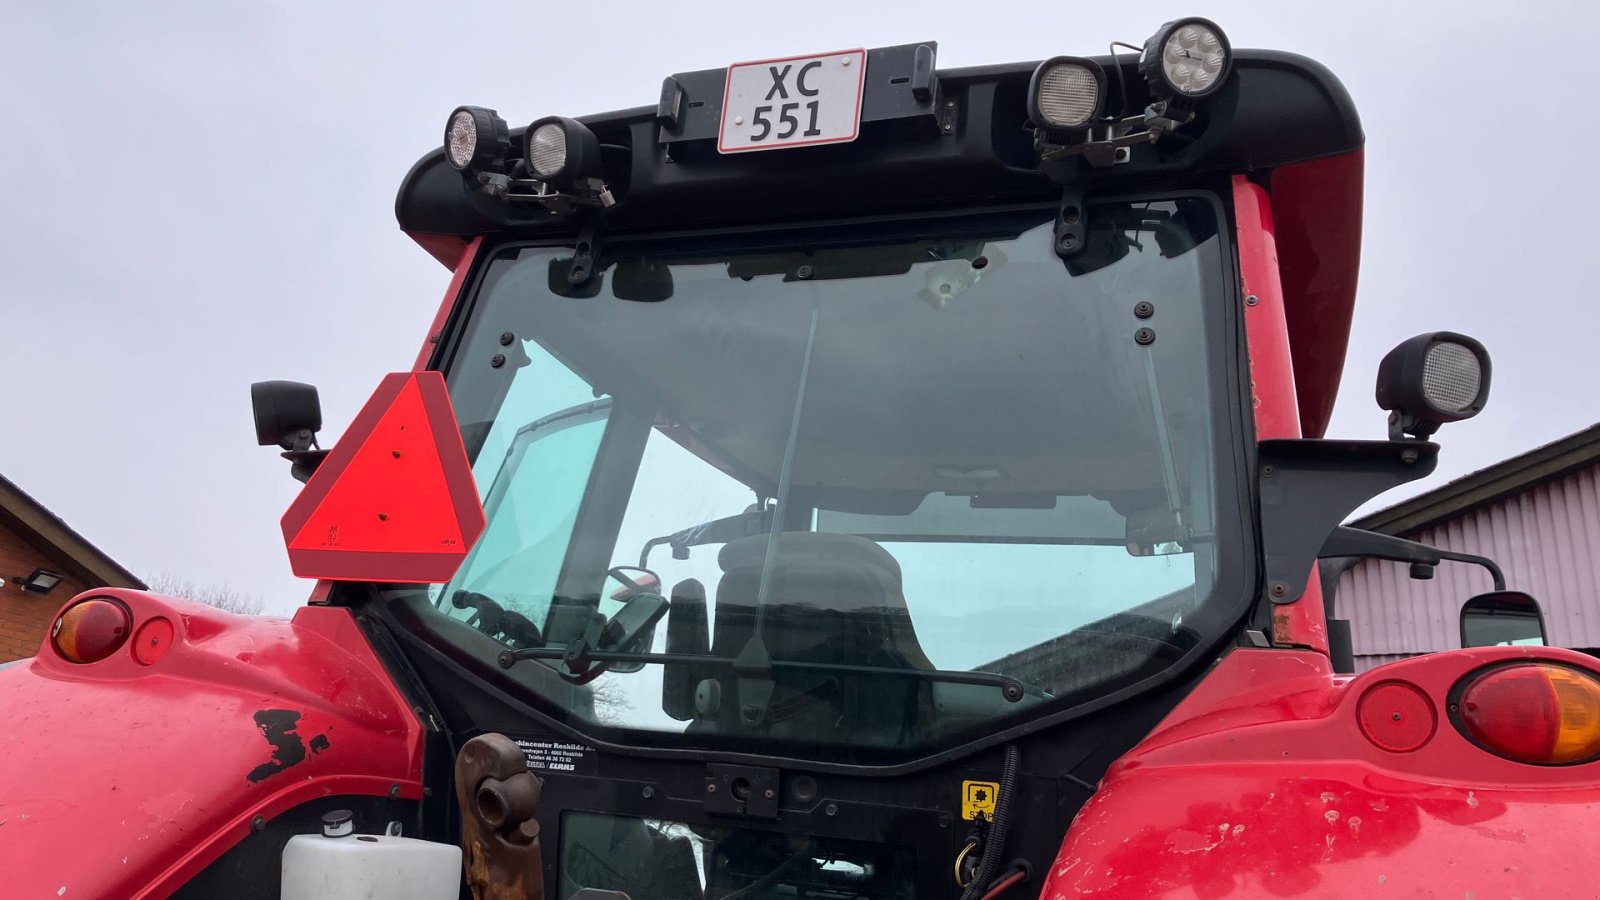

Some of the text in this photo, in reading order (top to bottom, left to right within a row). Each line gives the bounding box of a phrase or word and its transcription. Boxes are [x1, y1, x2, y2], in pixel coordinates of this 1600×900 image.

[765, 61, 822, 100] XC
[750, 101, 821, 141] 551
[554, 742, 584, 750] Roskilde
[549, 762, 575, 771] CLAAS
